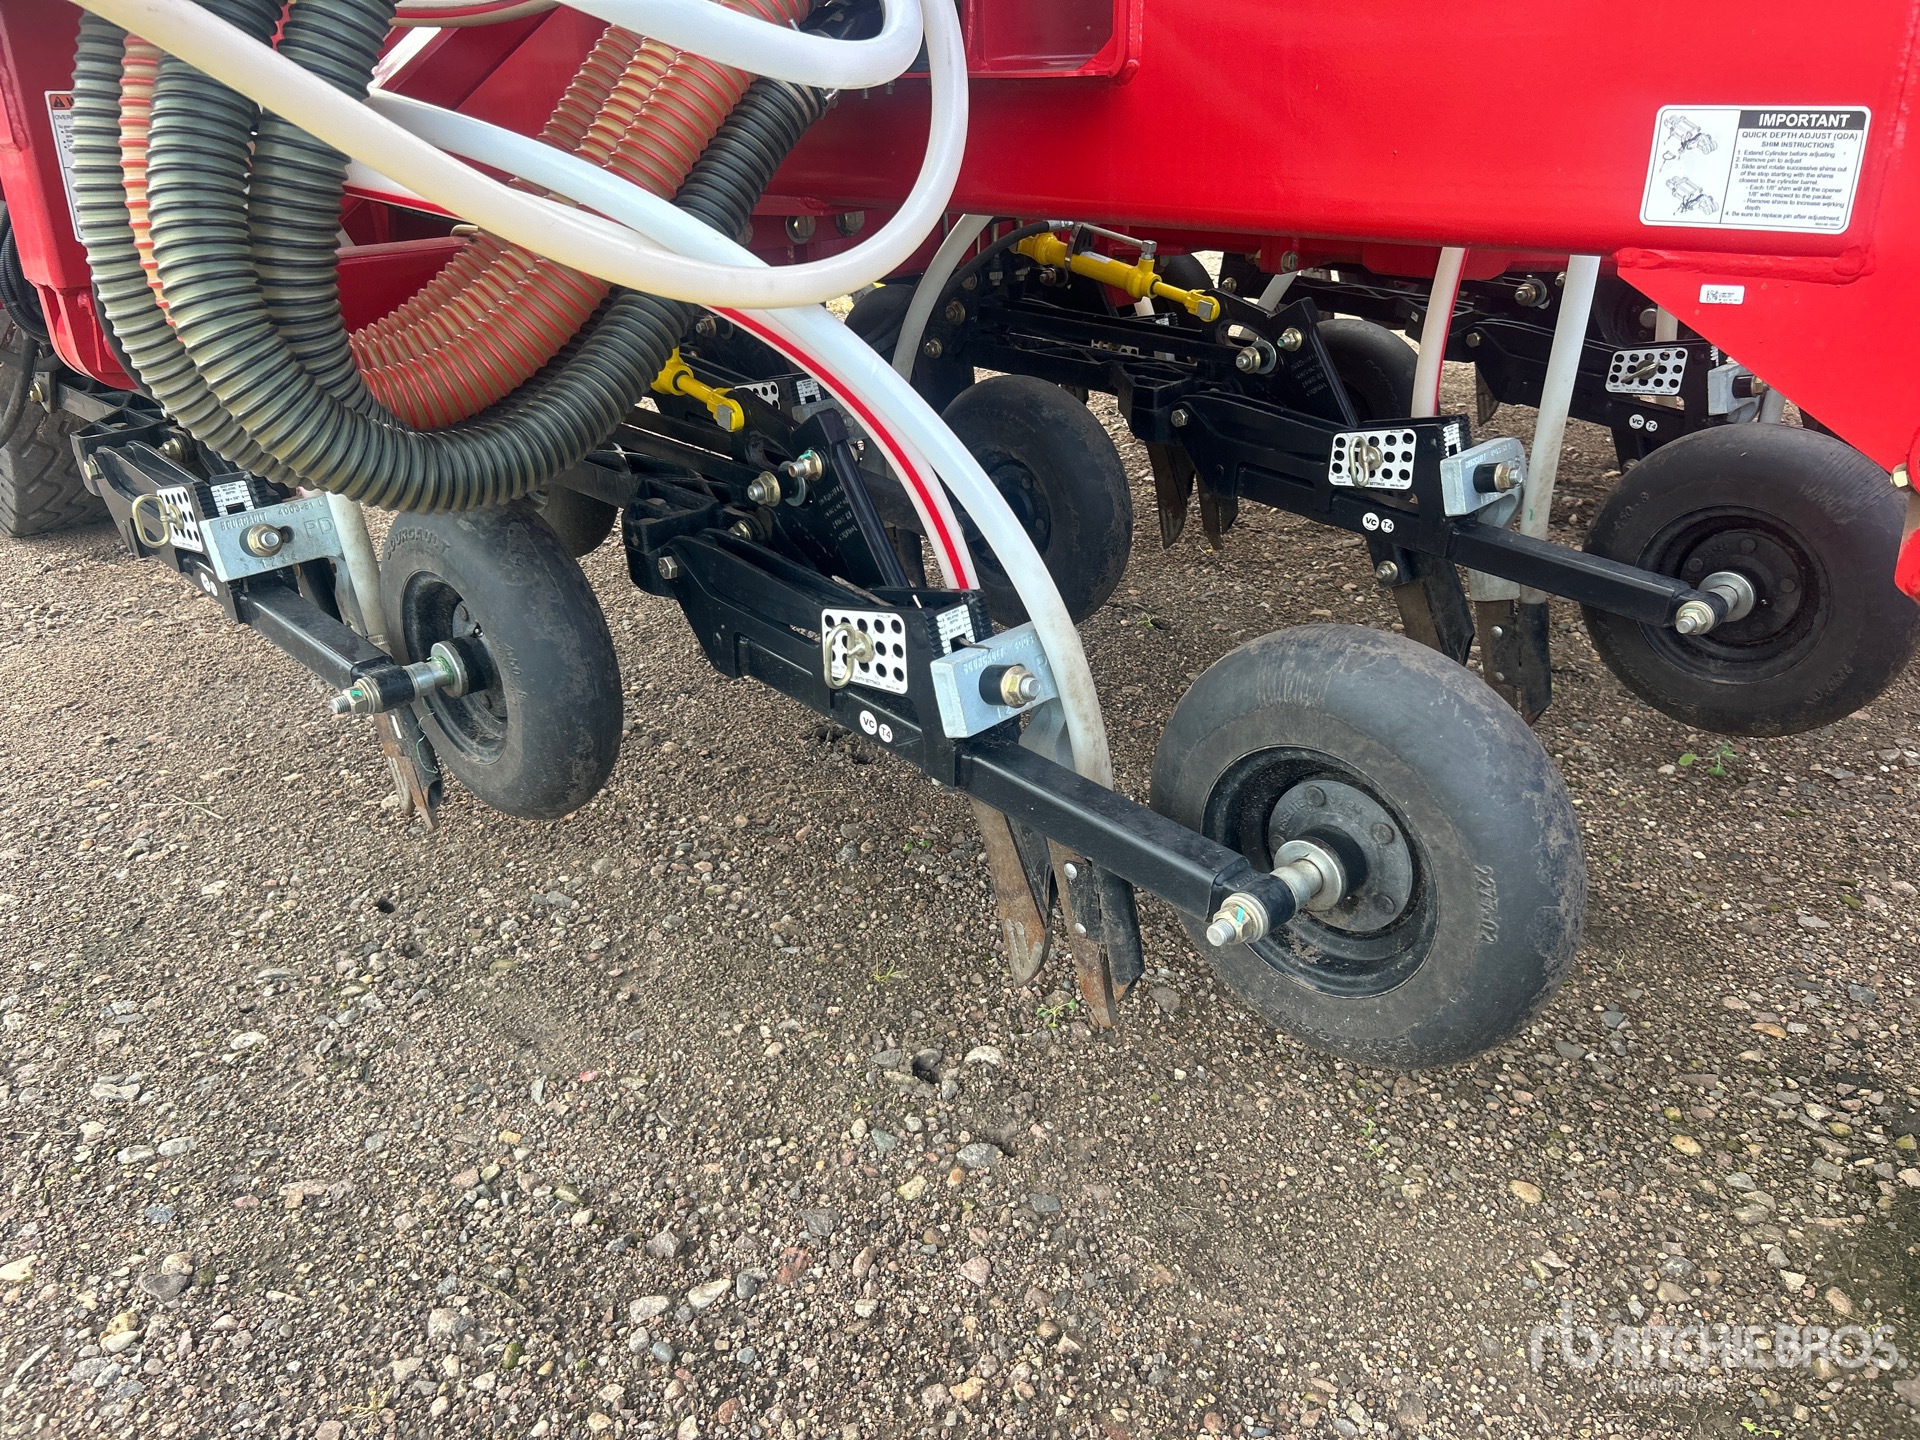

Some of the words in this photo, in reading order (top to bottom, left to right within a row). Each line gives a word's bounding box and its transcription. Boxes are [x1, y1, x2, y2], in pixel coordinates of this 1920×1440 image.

[1759, 114, 1850, 127] IMPORTANT
[1742, 131, 1768, 139] QUICK
[1799, 132, 1832, 140] ADJUST
[1834, 132, 1858, 141] (QDA)
[1365, 516, 1377, 527] VC
[1383, 520, 1393, 530] T4
[862, 716, 875, 728] VC
[880, 726, 891, 739] T4
